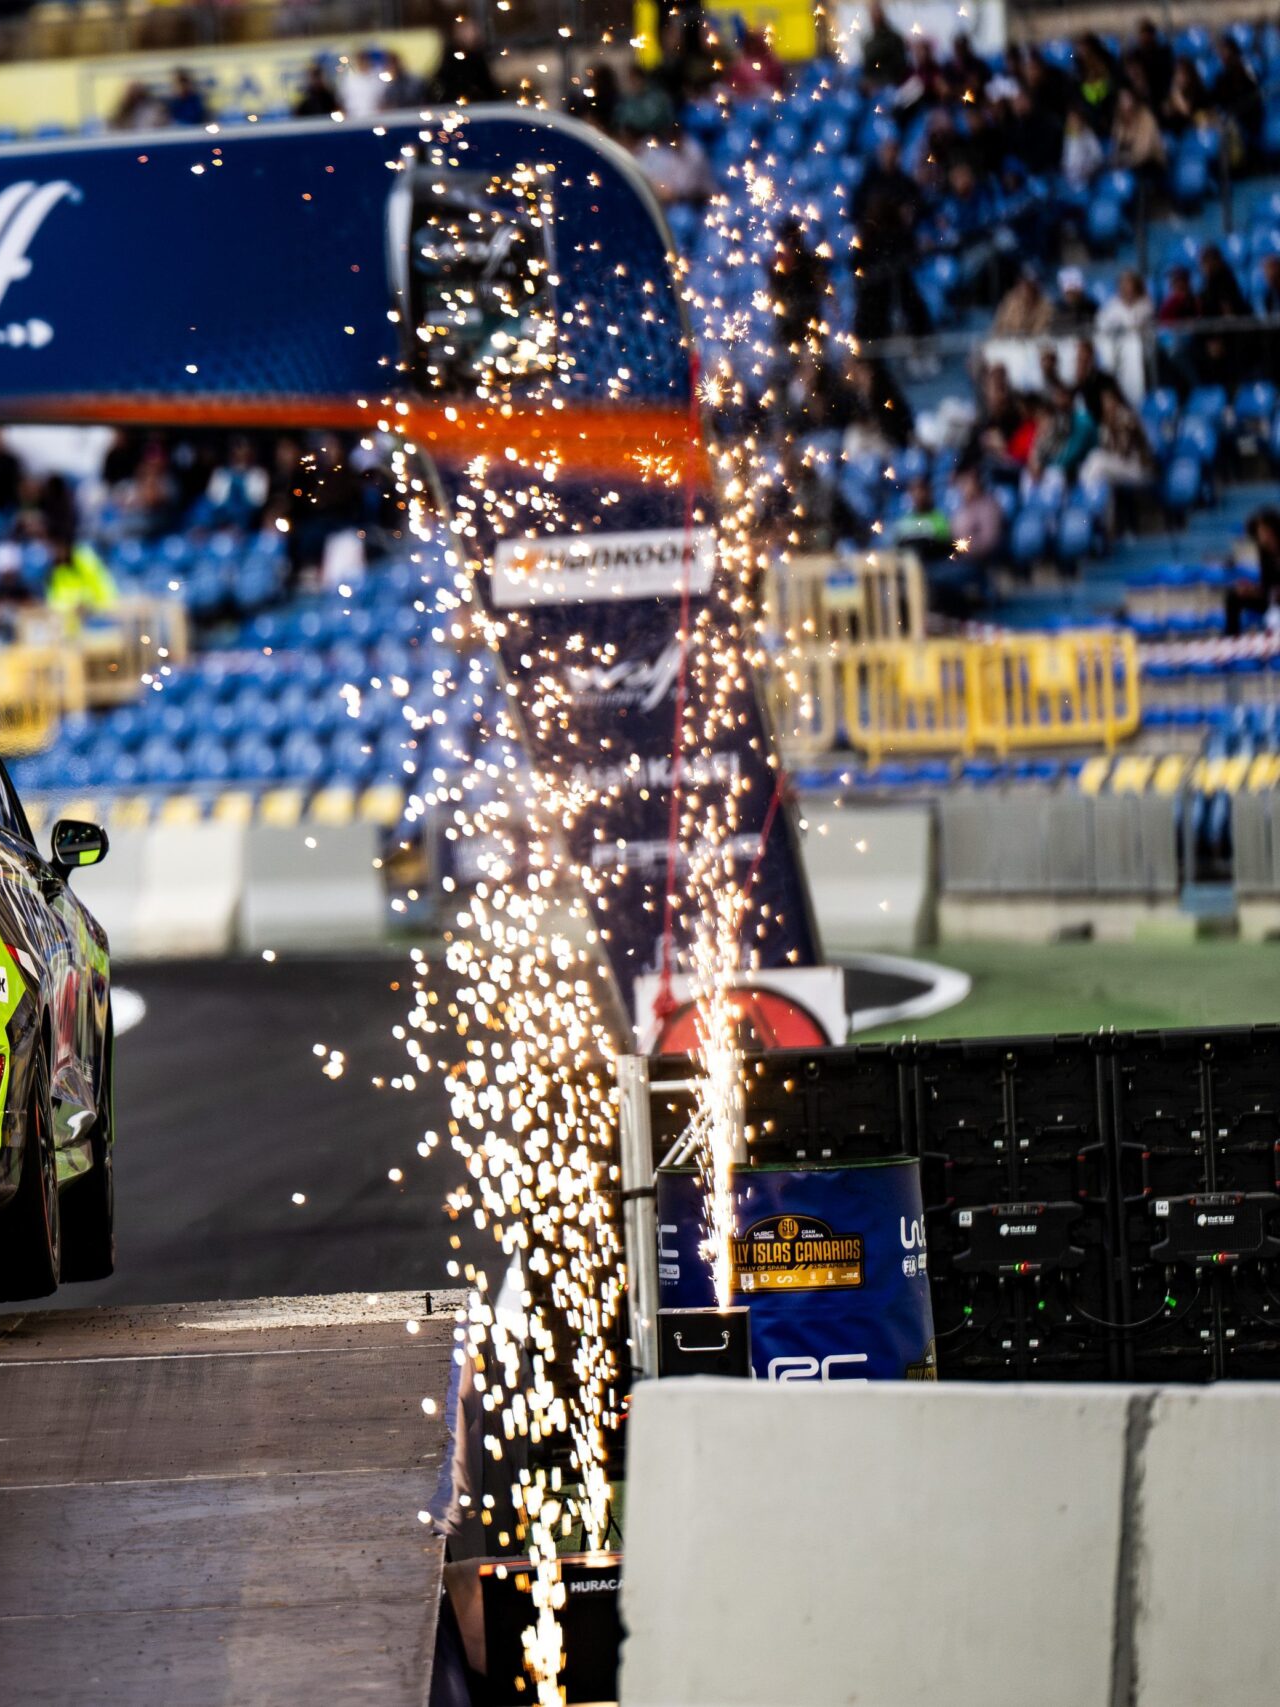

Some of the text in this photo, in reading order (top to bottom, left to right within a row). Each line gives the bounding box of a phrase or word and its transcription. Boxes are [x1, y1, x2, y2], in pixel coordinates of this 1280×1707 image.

[753, 1241, 791, 1264] ISLAS
[795, 1239, 861, 1263] CANARIAS
[751, 1353, 868, 1385] RC
